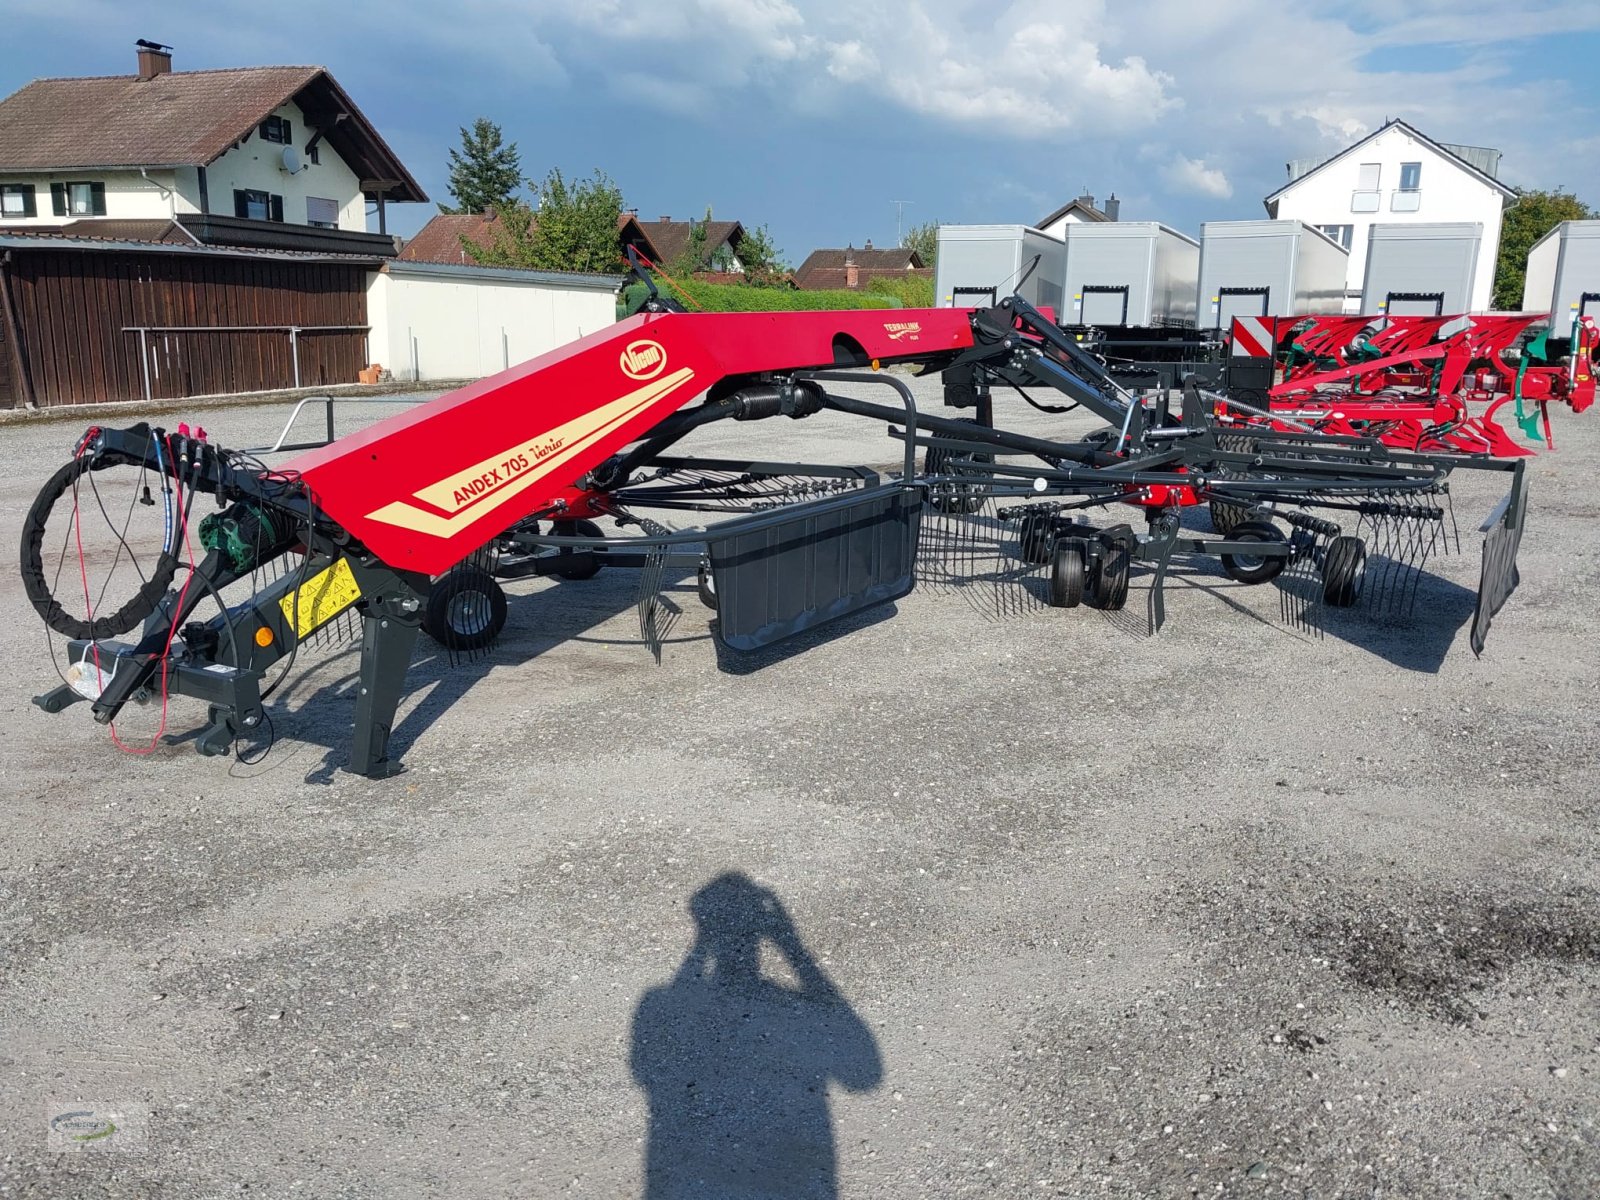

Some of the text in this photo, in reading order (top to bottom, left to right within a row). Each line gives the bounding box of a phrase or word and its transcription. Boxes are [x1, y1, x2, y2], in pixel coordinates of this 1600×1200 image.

[883, 322, 920, 332] TERRALINK
[621, 342, 663, 376] Vicon
[453, 437, 565, 506] ANDEX 705 Vario
